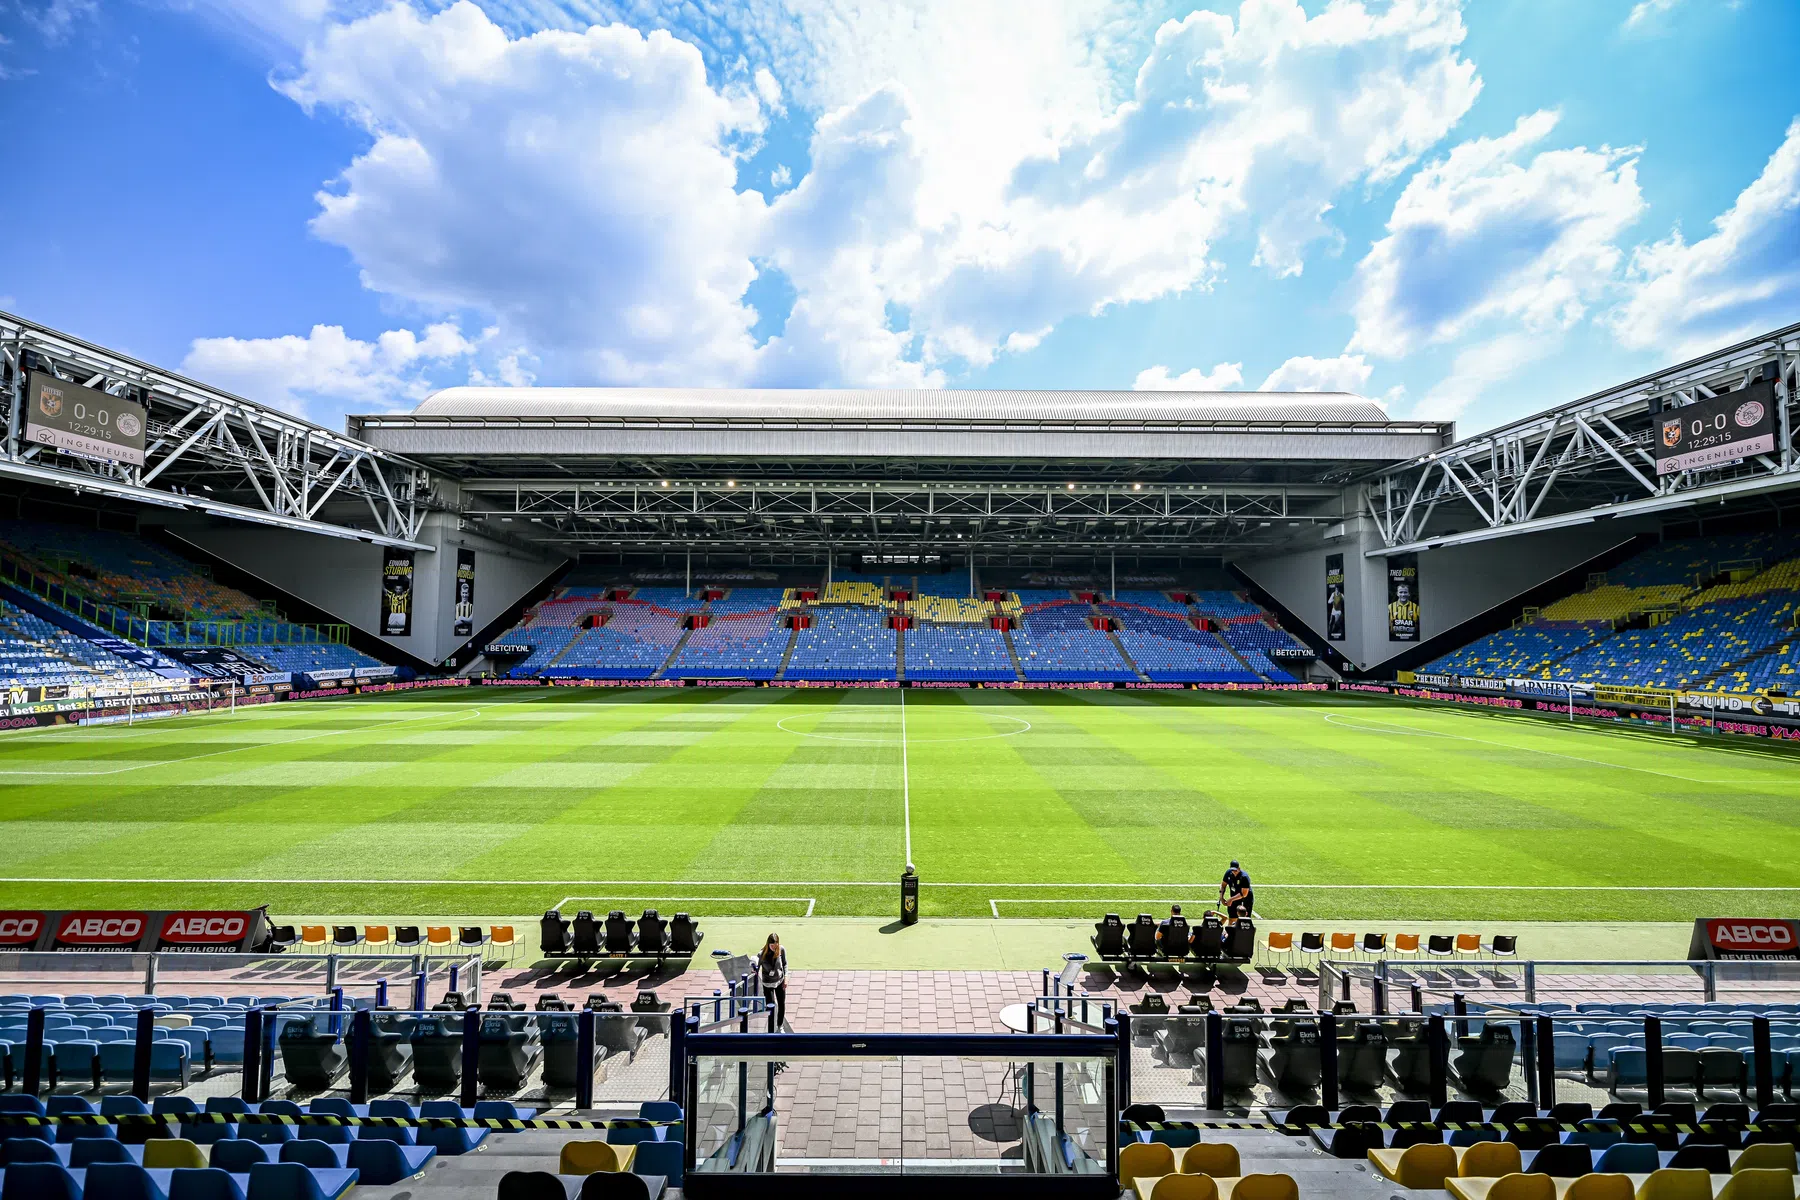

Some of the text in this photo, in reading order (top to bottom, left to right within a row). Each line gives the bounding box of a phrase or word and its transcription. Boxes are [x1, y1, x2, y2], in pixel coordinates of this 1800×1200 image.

[68, 421, 112, 440] 12:29:15
[38, 432, 53, 444] SK
[61, 437, 135, 460] INGENIEURS
[1688, 432, 1732, 450] 12:29:15
[1666, 462, 1677, 472] SK
[1684, 443, 1761, 465] INGENIEURS
[388, 559, 410, 567] EDWARD
[384, 566, 413, 576] STURING
[1389, 567, 1416, 577] THEO BOS
[490, 644, 530, 652] BETCITY.NL
[1276, 649, 1316, 657] BETCITY.NL
[1429, 675, 1450, 686] EAGLE
[1475, 679, 1504, 690] LANDED
[57, 701, 95, 712] bet365
[1536, 701, 1549, 711] DE
[1690, 694, 1743, 711] ZUID
[13, 704, 55, 716] bet365
[62, 918, 142, 937] ABCO
[166, 917, 245, 936] ABCO
[1715, 925, 1791, 944] ABCO
[287, 1026, 303, 1034] Ekris
[1494, 1032, 1509, 1041] Ekris
